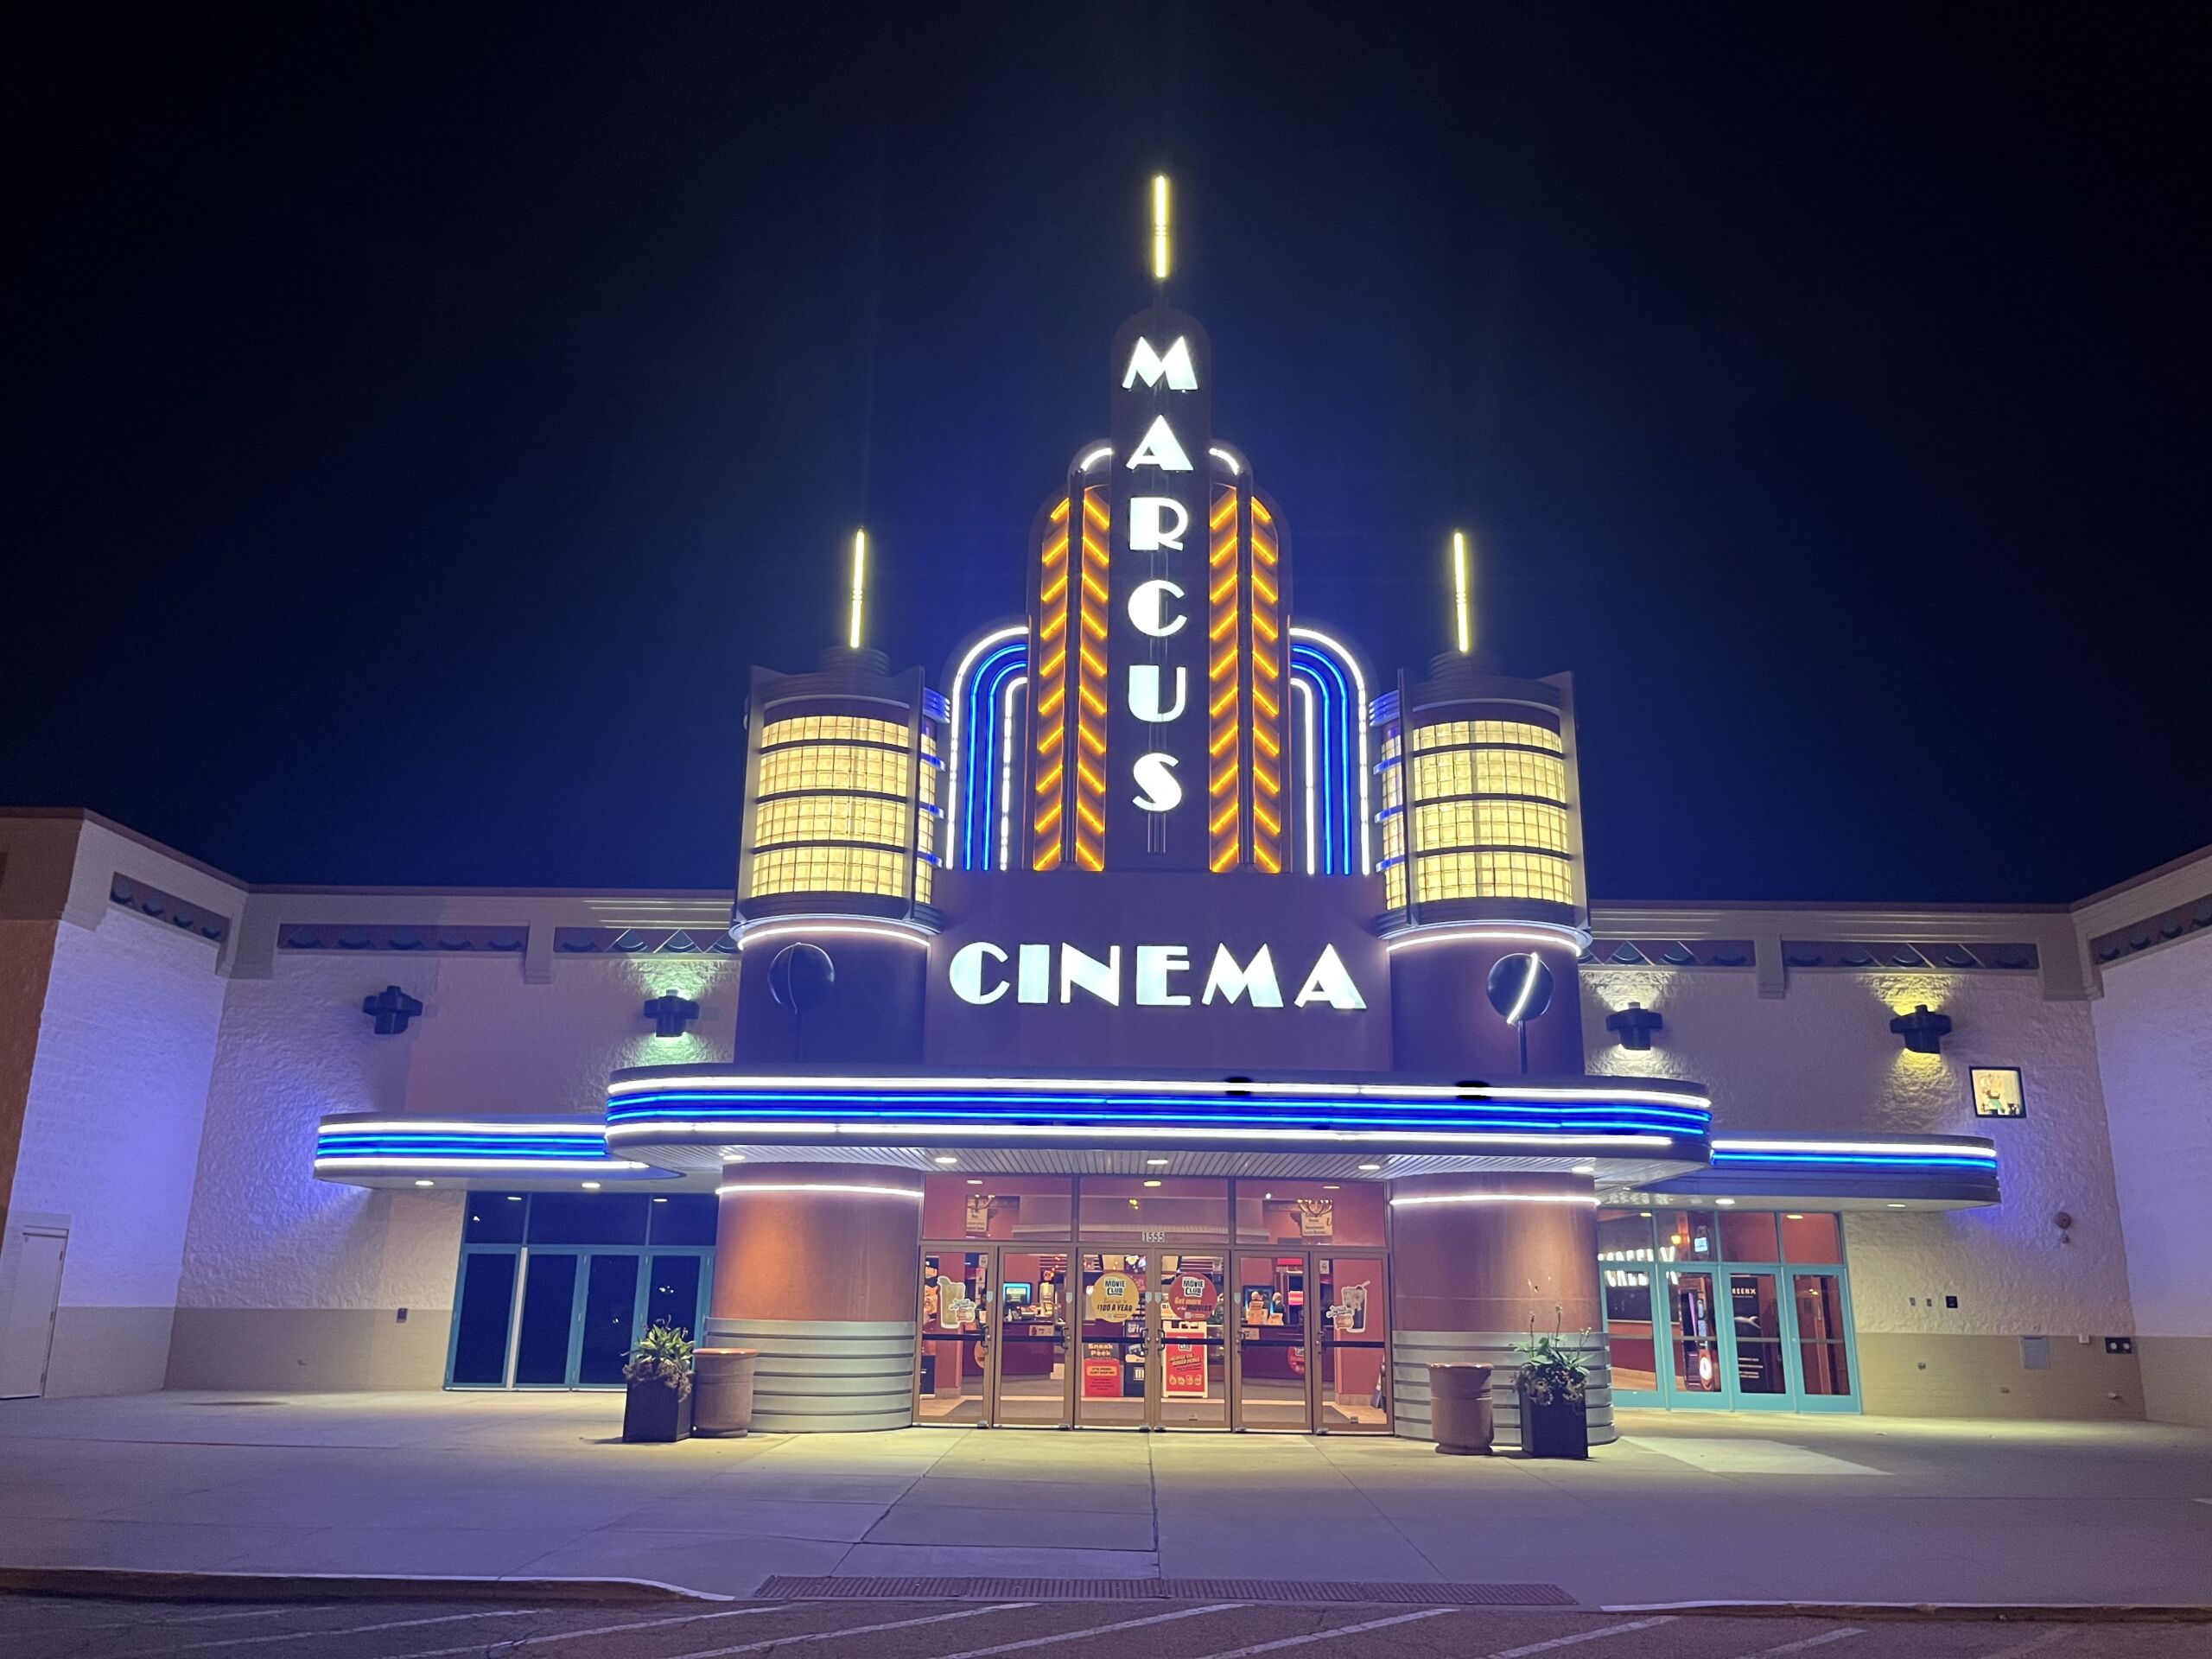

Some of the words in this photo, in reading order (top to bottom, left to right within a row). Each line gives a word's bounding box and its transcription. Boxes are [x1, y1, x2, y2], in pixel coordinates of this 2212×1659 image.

[1122, 335, 1198, 812] MARCUS
[949, 941, 1367, 1008] CINEMA
[1143, 1232, 1164, 1242] 1555
[1107, 1287, 1123, 1296] CLUB
[1185, 1287, 1201, 1296] CLUB
[1174, 1296, 1185, 1305] Get
